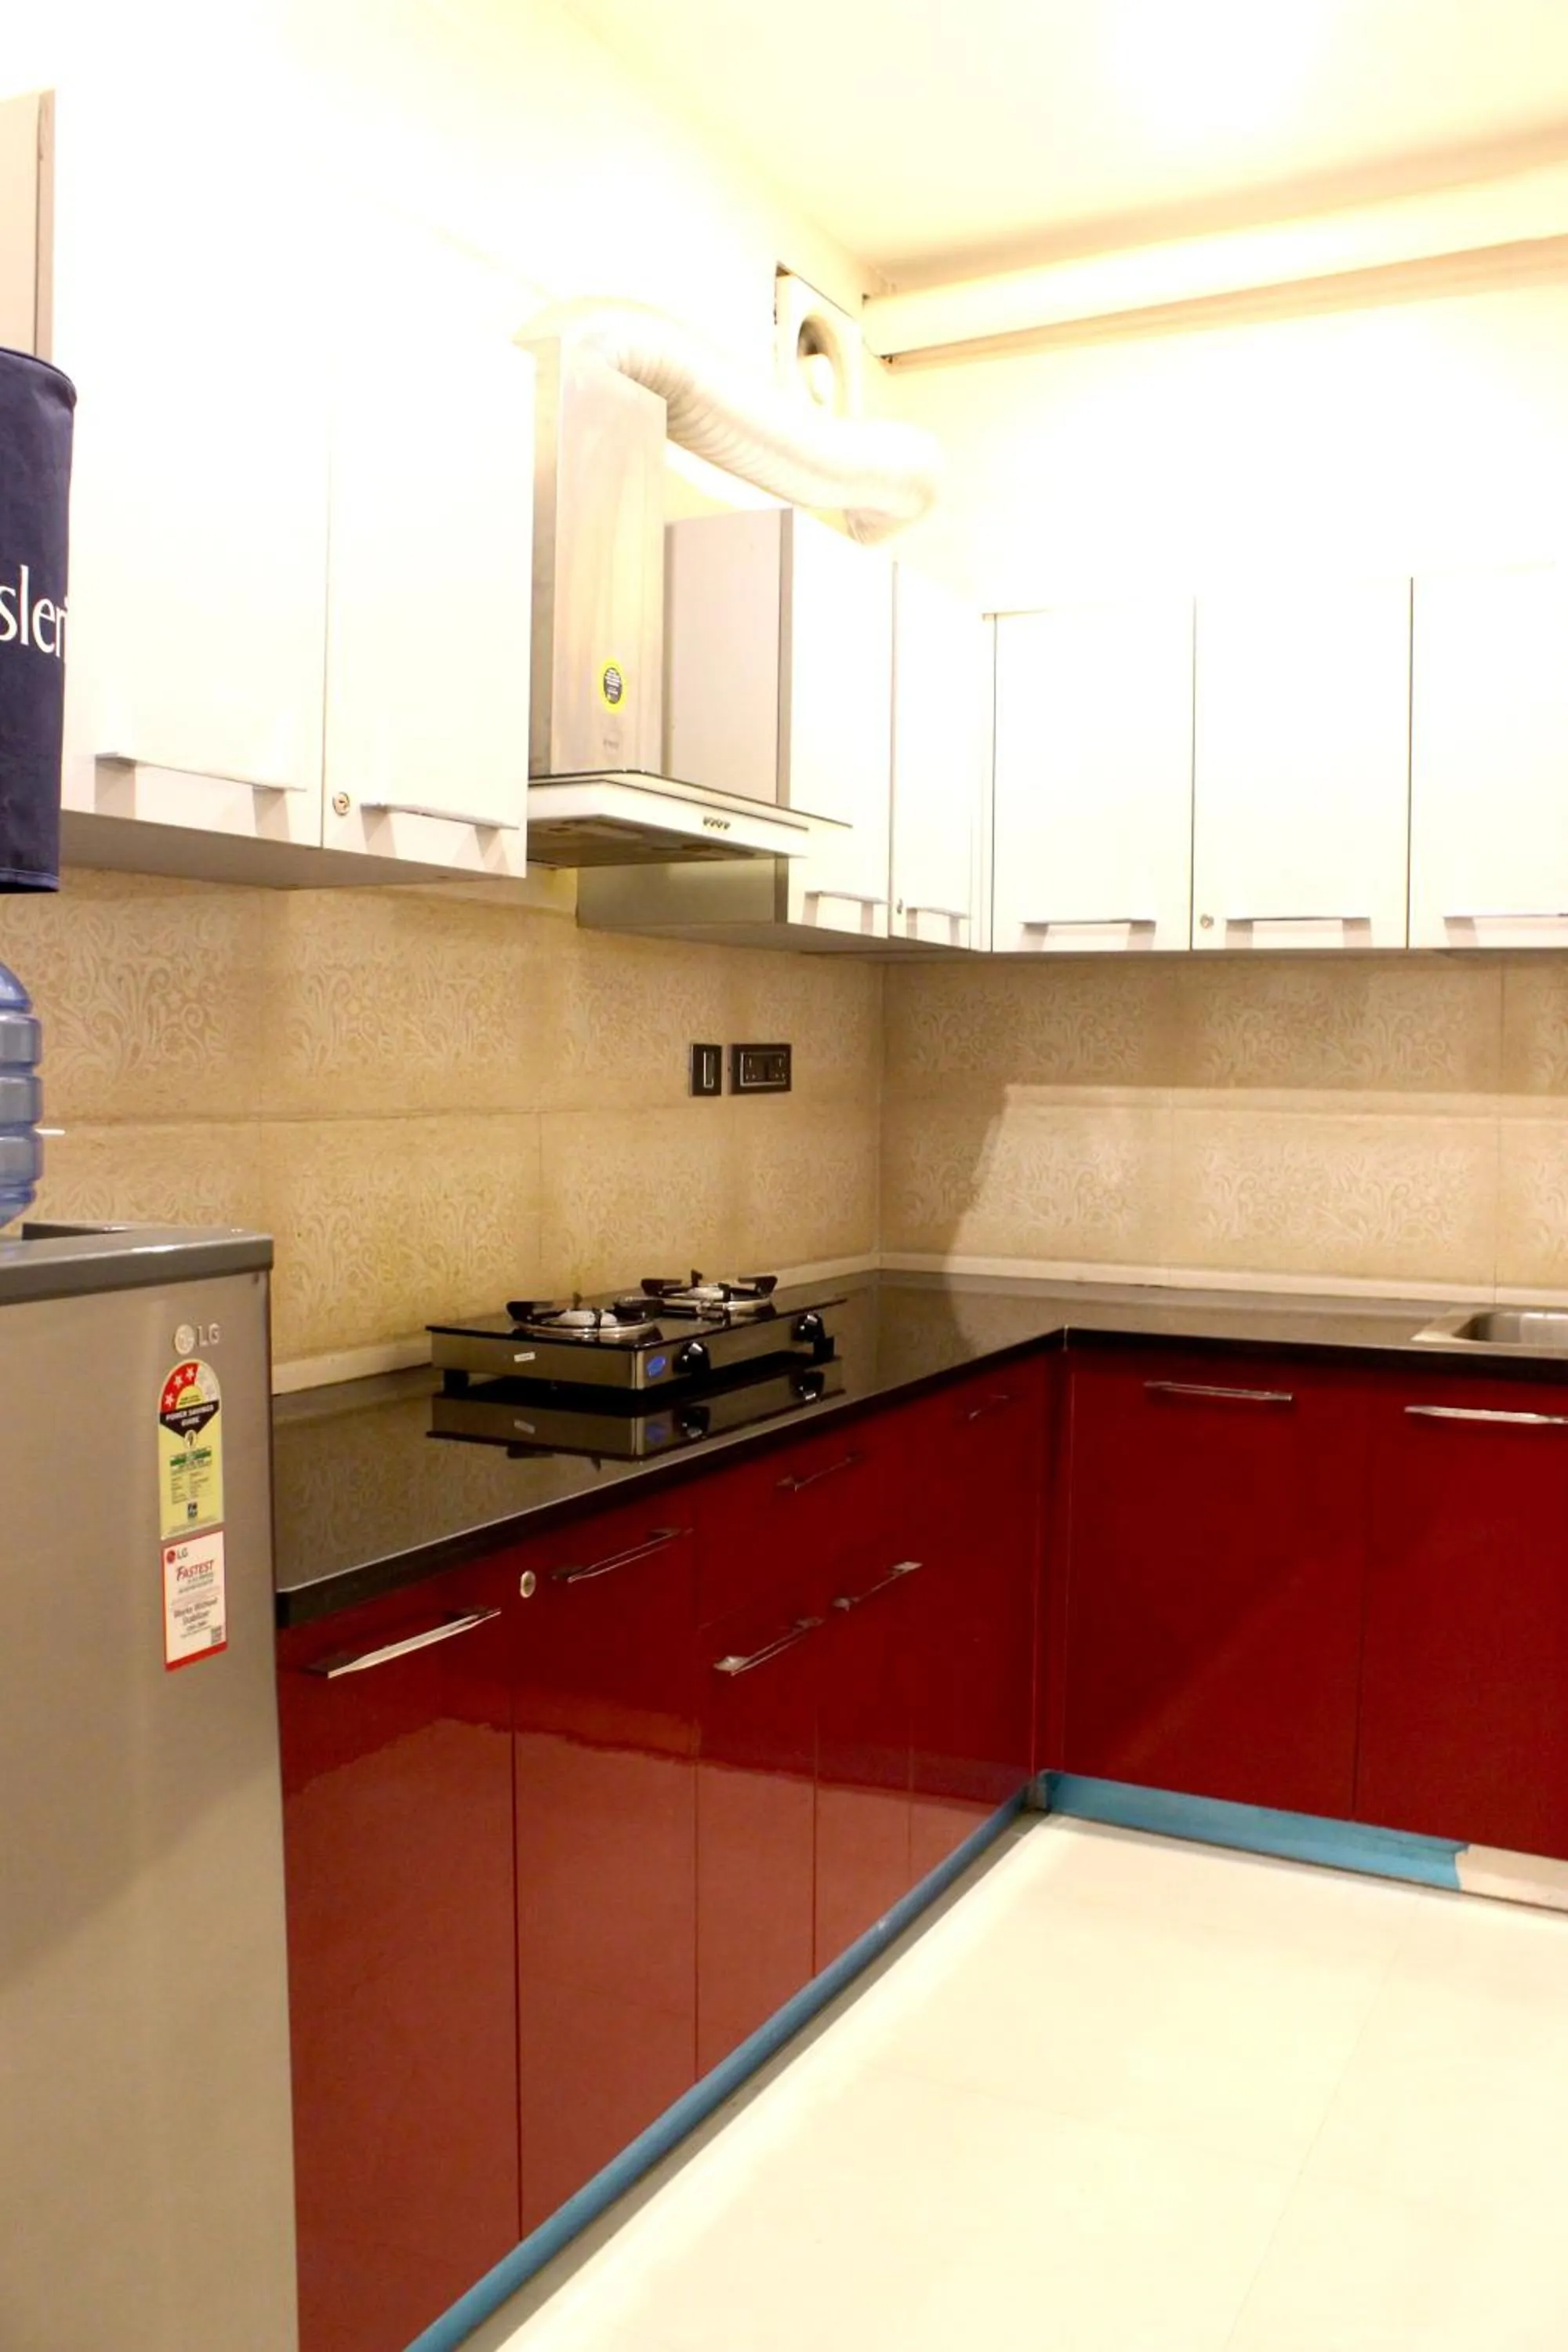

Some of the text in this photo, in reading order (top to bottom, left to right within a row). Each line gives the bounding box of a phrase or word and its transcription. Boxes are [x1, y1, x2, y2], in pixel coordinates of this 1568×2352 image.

[198, 1323, 220, 1346] LG
[177, 1548, 188, 1559] LG
[176, 1560, 213, 1581] FASTEST
